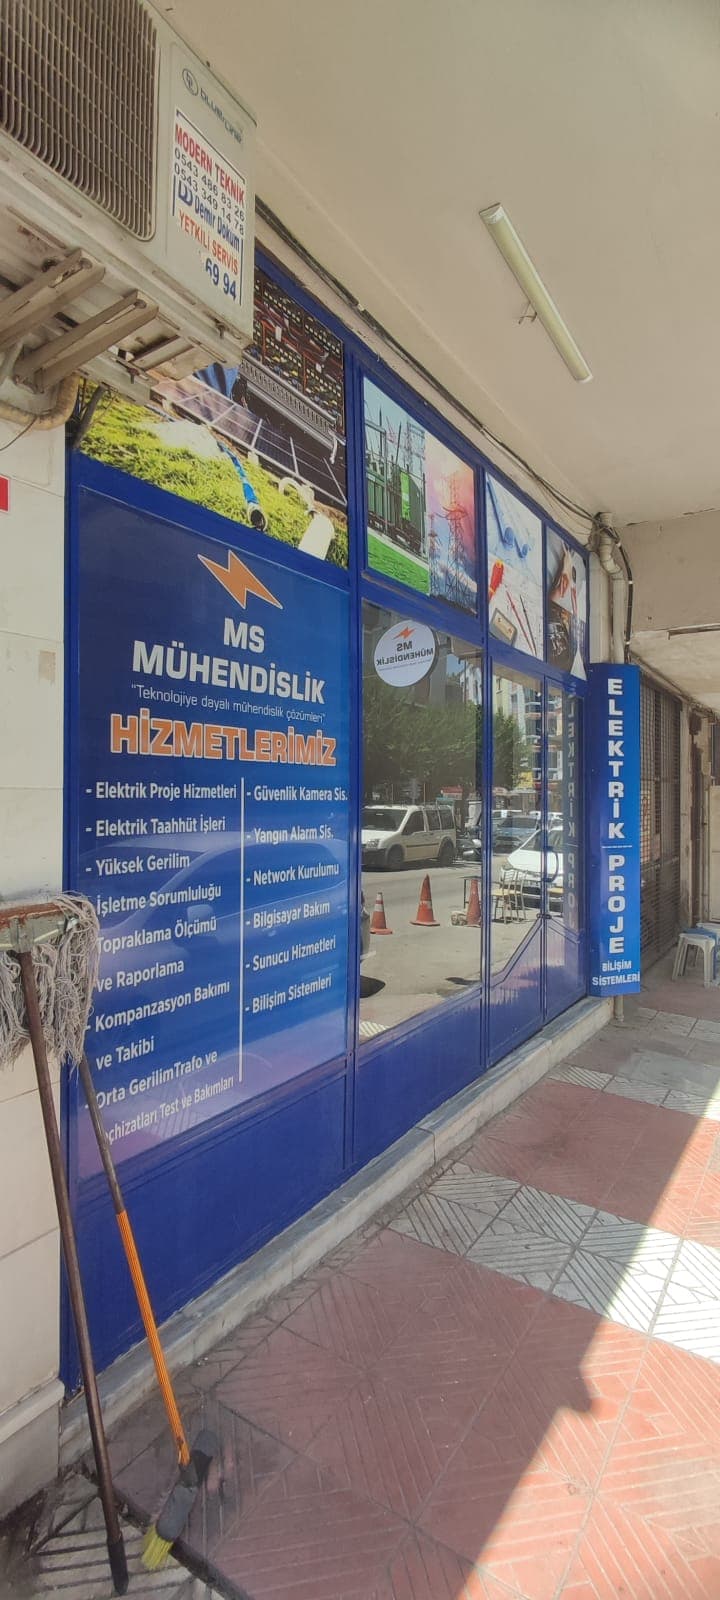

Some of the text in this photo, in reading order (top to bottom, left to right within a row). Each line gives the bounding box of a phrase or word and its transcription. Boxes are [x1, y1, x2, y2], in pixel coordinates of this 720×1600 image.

[175, 123, 213, 177] MODERN
[174, 147, 199, 178] 0543
[234, 205, 245, 222] 26
[174, 162, 198, 193] 0543
[201, 187, 218, 210] 349
[221, 207, 232, 223] 14
[194, 194, 216, 229] Demir
[222, 271, 237, 301] 94
[223, 617, 265, 653] MS
[132, 640, 326, 704] MÜHENDİSLİK
[201, 695, 230, 711] dayalı
[233, 701, 284, 718] mühendislik
[110, 707, 337, 767] HİZMETLERİMİZ
[607, 678, 625, 839] ELEKTRİK
[96, 782, 237, 801] Elektrik Proje Hizmetleri
[254, 785, 348, 801] Güvenlik Kamera Sis.
[96, 814, 226, 837] Elektrik Taahhüt İşleri
[254, 824, 334, 845] Yangın Alarm Sis.
[96, 852, 190, 876] Yüksek Gerilim
[253, 862, 340, 886] Network Kurulumu
[97, 883, 222, 918] İşletme Sorumluluğu
[253, 901, 331, 929] Bilgisayar Bakım
[607, 855, 626, 954] PROJE
[96, 916, 217, 954] Topraklama Ölçümü
[252, 934, 336, 971] Sunucu Hizmetleri
[97, 960, 185, 992] ve Raporlama
[592, 971, 640, 986] SİSTEMLERİ
[602, 959, 632, 973] BİLİŞİM
[95, 980, 230, 1032] Kompanzasyon Bakımı
[252, 972, 332, 1013] Bilişim Sistemleri
[96, 1035, 154, 1070] ve Takibi
[97, 1087, 126, 1109] Orta
[205, 1050, 218, 1065] ve
[105, 1075, 234, 1145] çhizatları Test ve Bakımları
